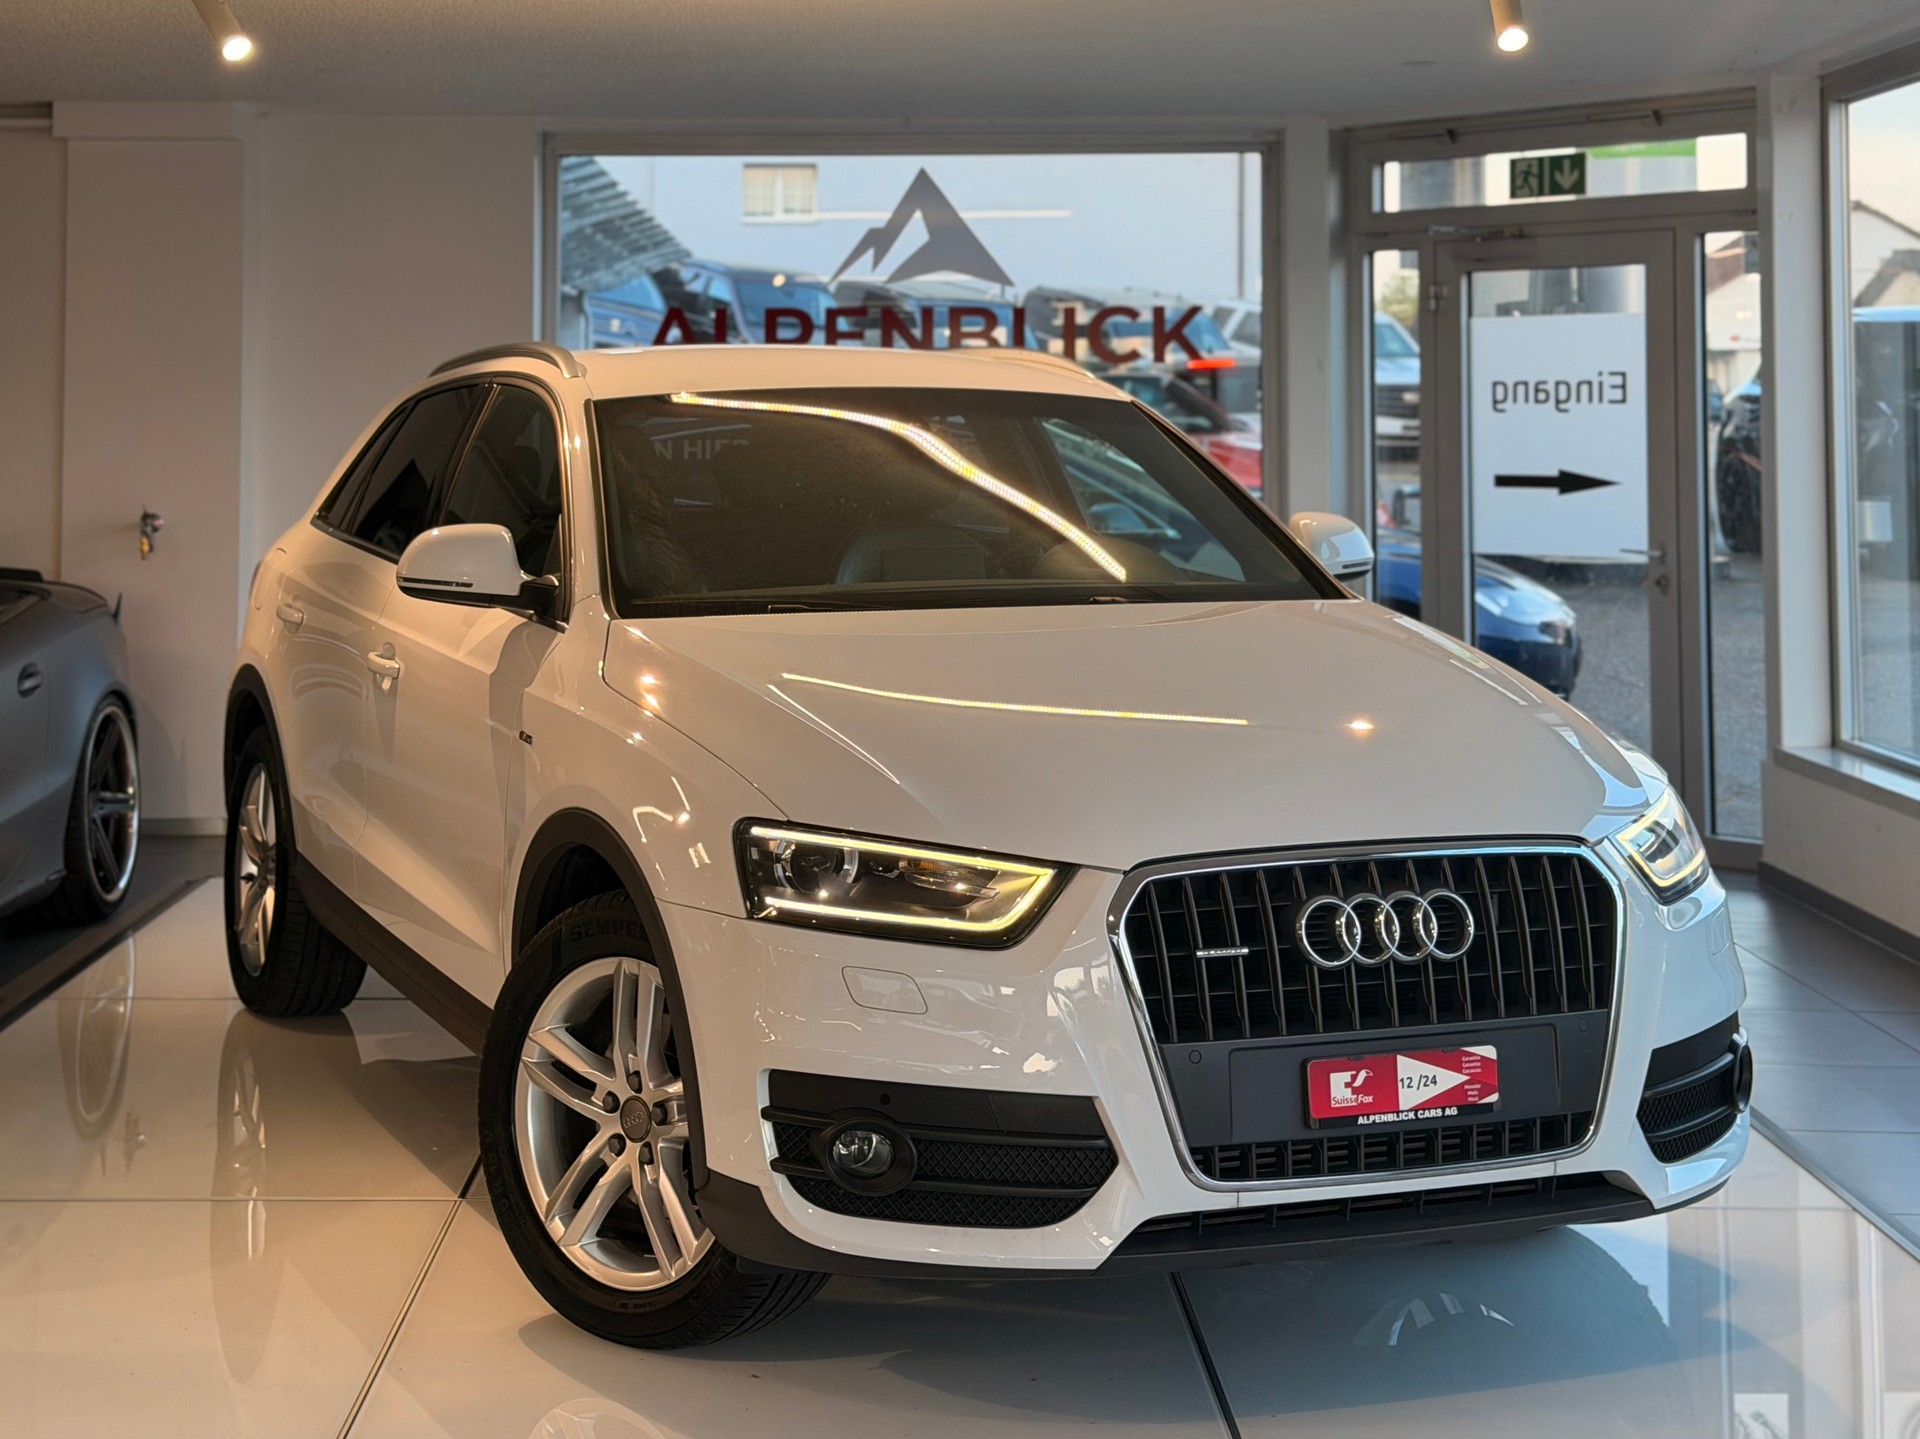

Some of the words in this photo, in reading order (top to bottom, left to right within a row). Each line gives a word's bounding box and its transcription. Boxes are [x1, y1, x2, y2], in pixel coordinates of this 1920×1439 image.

[569, 918, 642, 942] SEMPE
[1399, 1076, 1414, 1090] 12
[1416, 1074, 1438, 1091] /24
[1357, 1111, 1416, 1125] ALPENBLICK
[1417, 1108, 1443, 1119] CARS
[1444, 1106, 1458, 1116] AG
